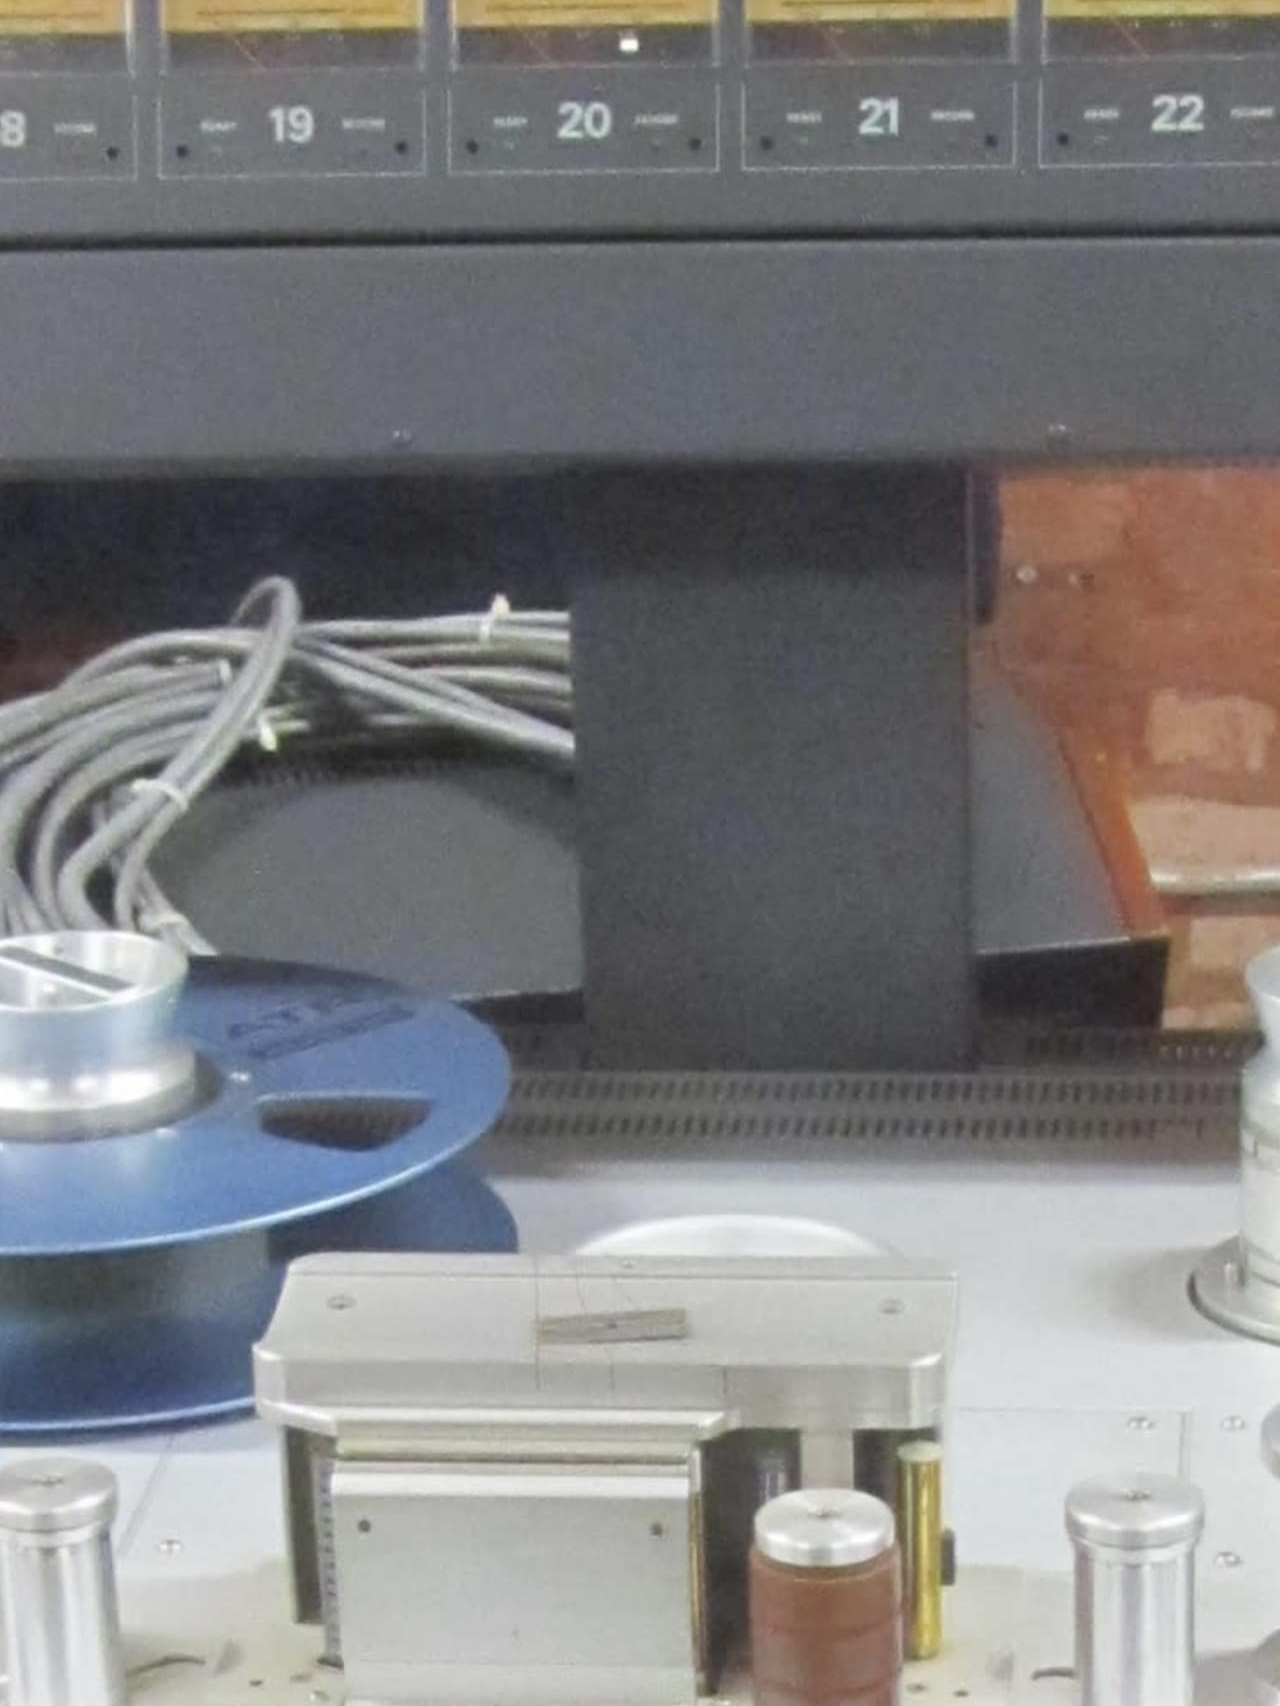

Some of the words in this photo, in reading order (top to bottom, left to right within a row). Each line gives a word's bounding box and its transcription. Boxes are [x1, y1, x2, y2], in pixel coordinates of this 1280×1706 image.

[268, 105, 315, 144] 19
[556, 101, 612, 140] 20
[858, 96, 900, 136] 21
[1150, 93, 1205, 133] 22
